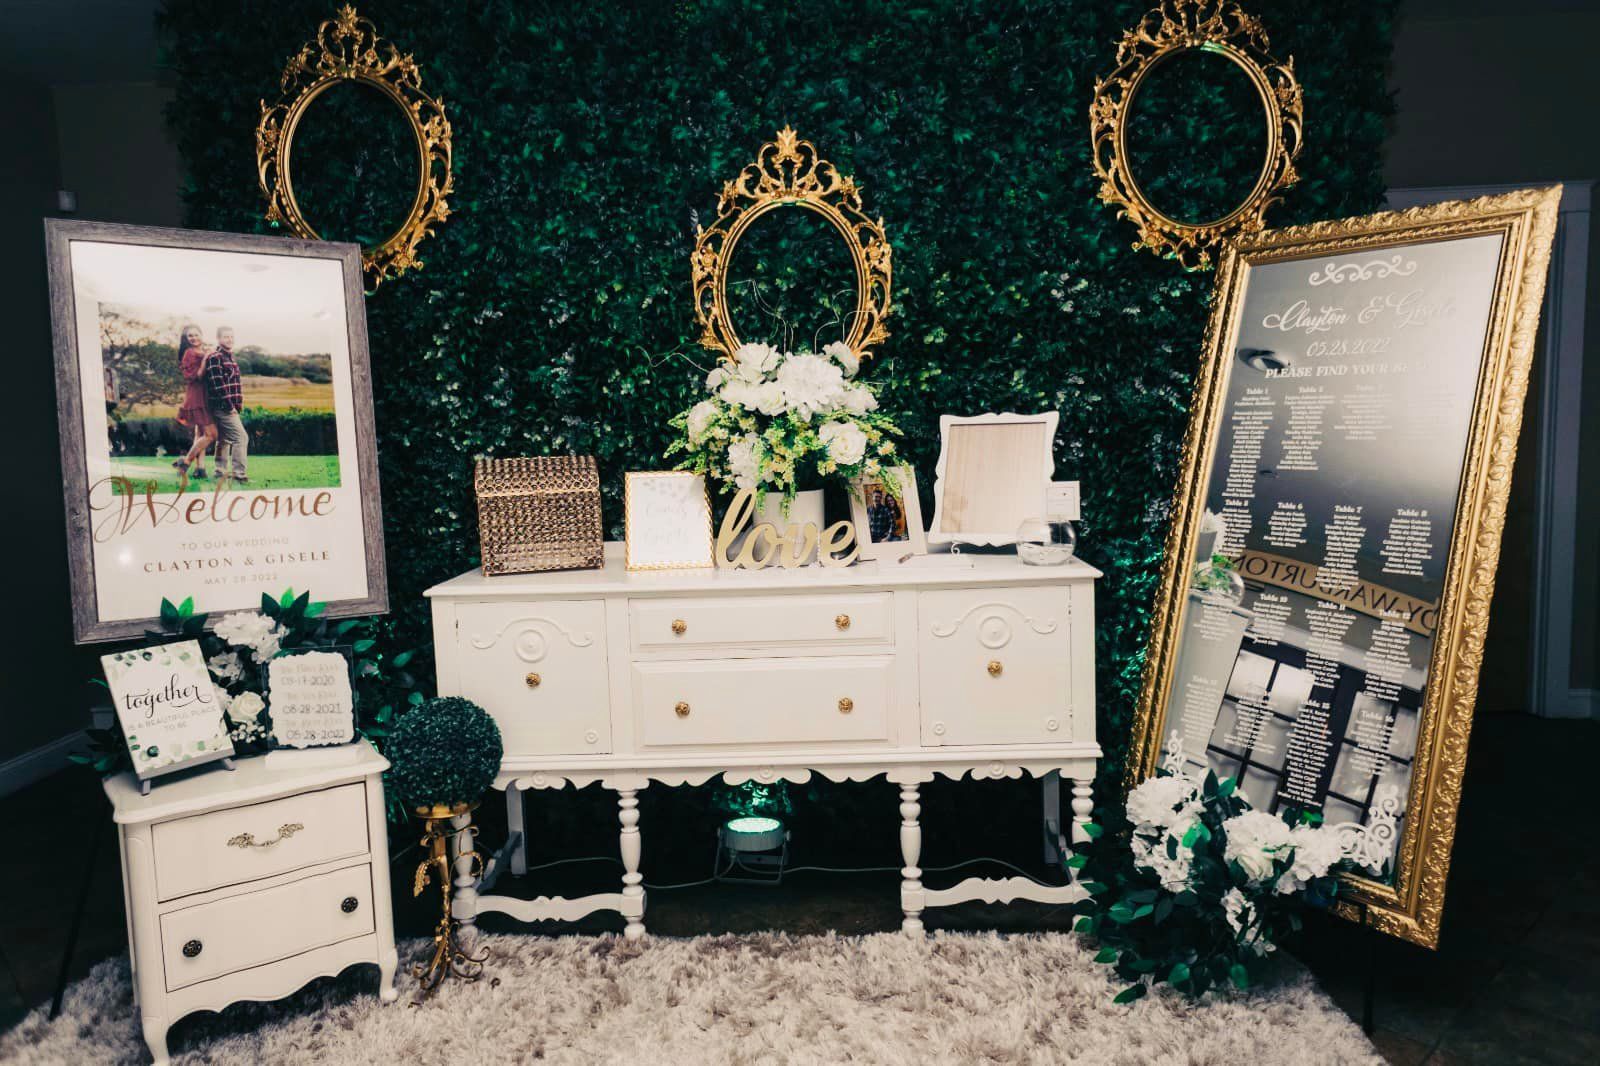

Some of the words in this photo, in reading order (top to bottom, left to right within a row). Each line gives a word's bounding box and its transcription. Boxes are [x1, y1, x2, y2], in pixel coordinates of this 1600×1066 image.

[1262, 299, 1350, 334] Clayton
[1358, 296, 1384, 325] &
[1264, 366, 1313, 379] PLEASE
[1316, 365, 1348, 377] FIND
[89, 470, 337, 544] Welcome
[1277, 501, 1297, 510] Table
[1333, 504, 1356, 513] Table
[1396, 508, 1420, 517] Table
[716, 487, 860, 569] love
[143, 557, 233, 573] CLAYTON
[243, 555, 255, 567] &
[264, 550, 330, 565] GISELE
[121, 672, 213, 719] together
